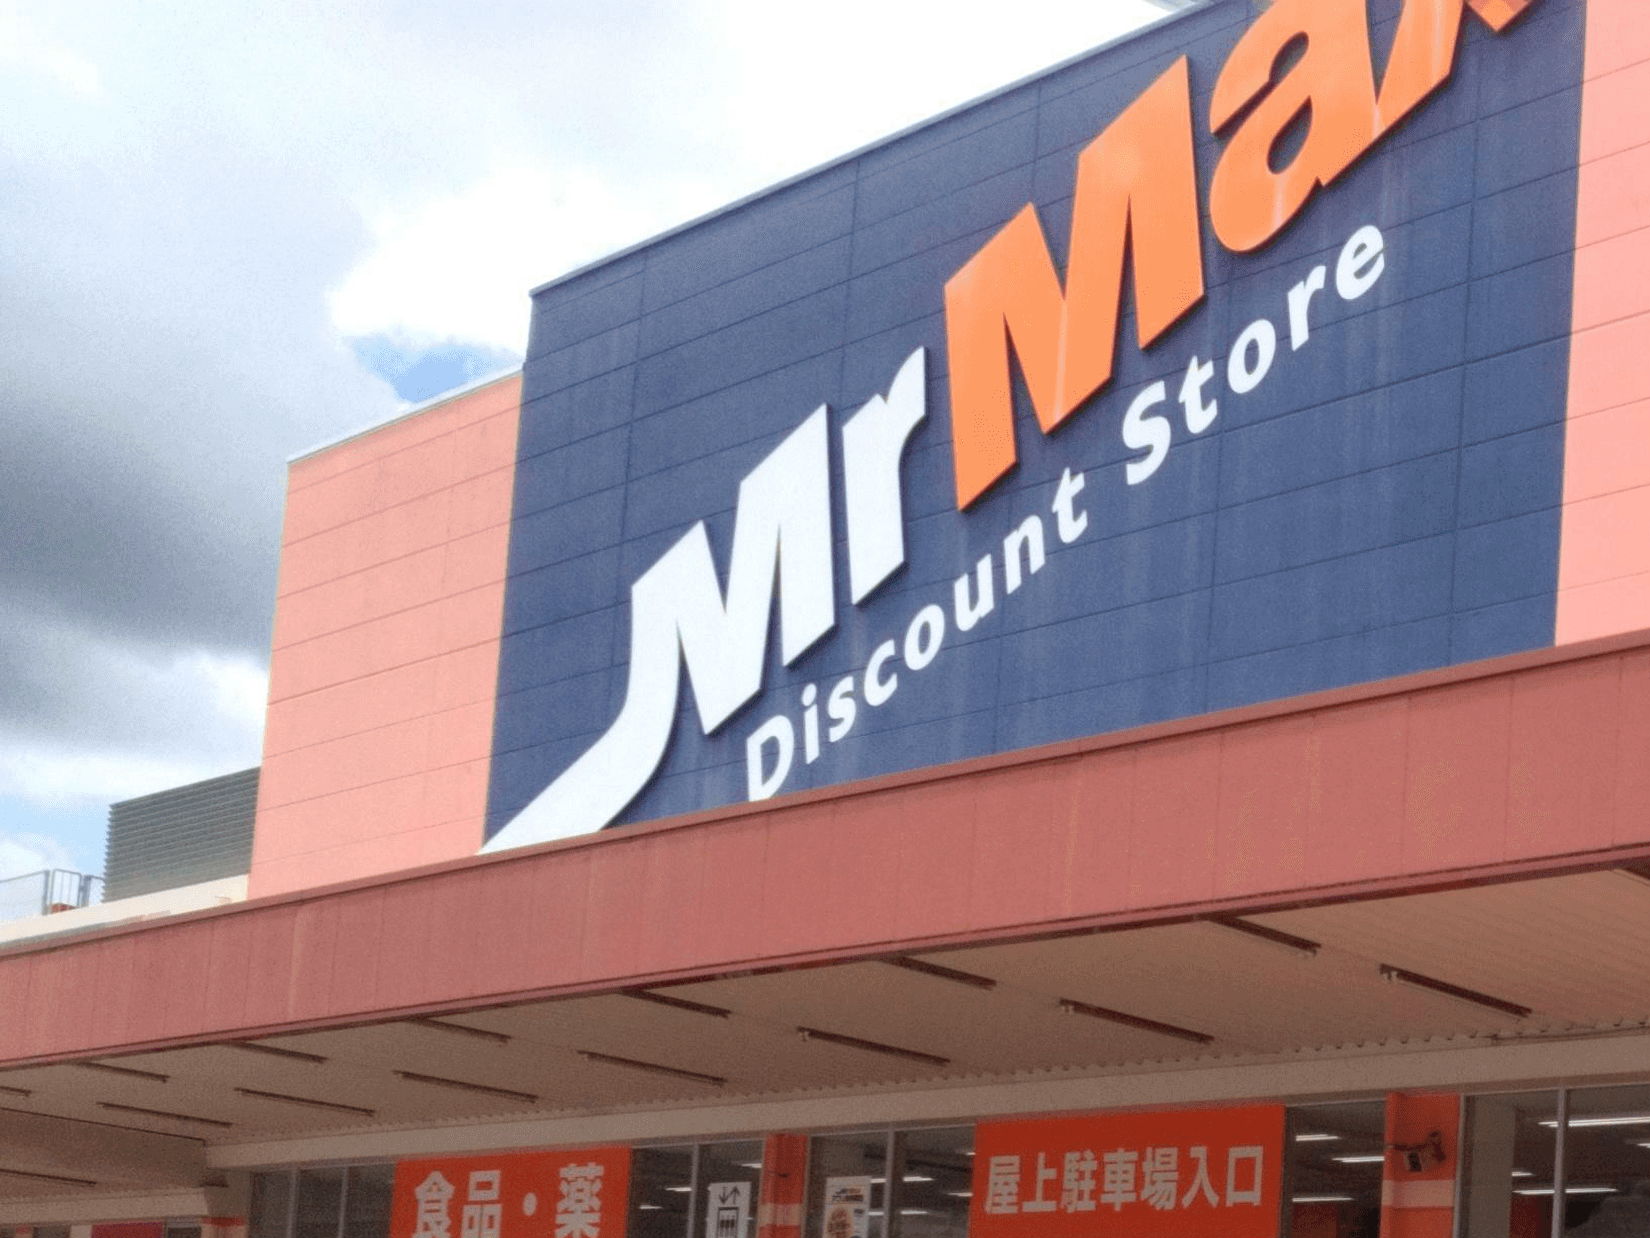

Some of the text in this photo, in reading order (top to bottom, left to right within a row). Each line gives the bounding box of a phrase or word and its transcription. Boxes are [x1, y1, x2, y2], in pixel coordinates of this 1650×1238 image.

[746, 224, 1387, 803] Discount Store
[985, 1146, 1264, 1214] 屋上駐車場入口
